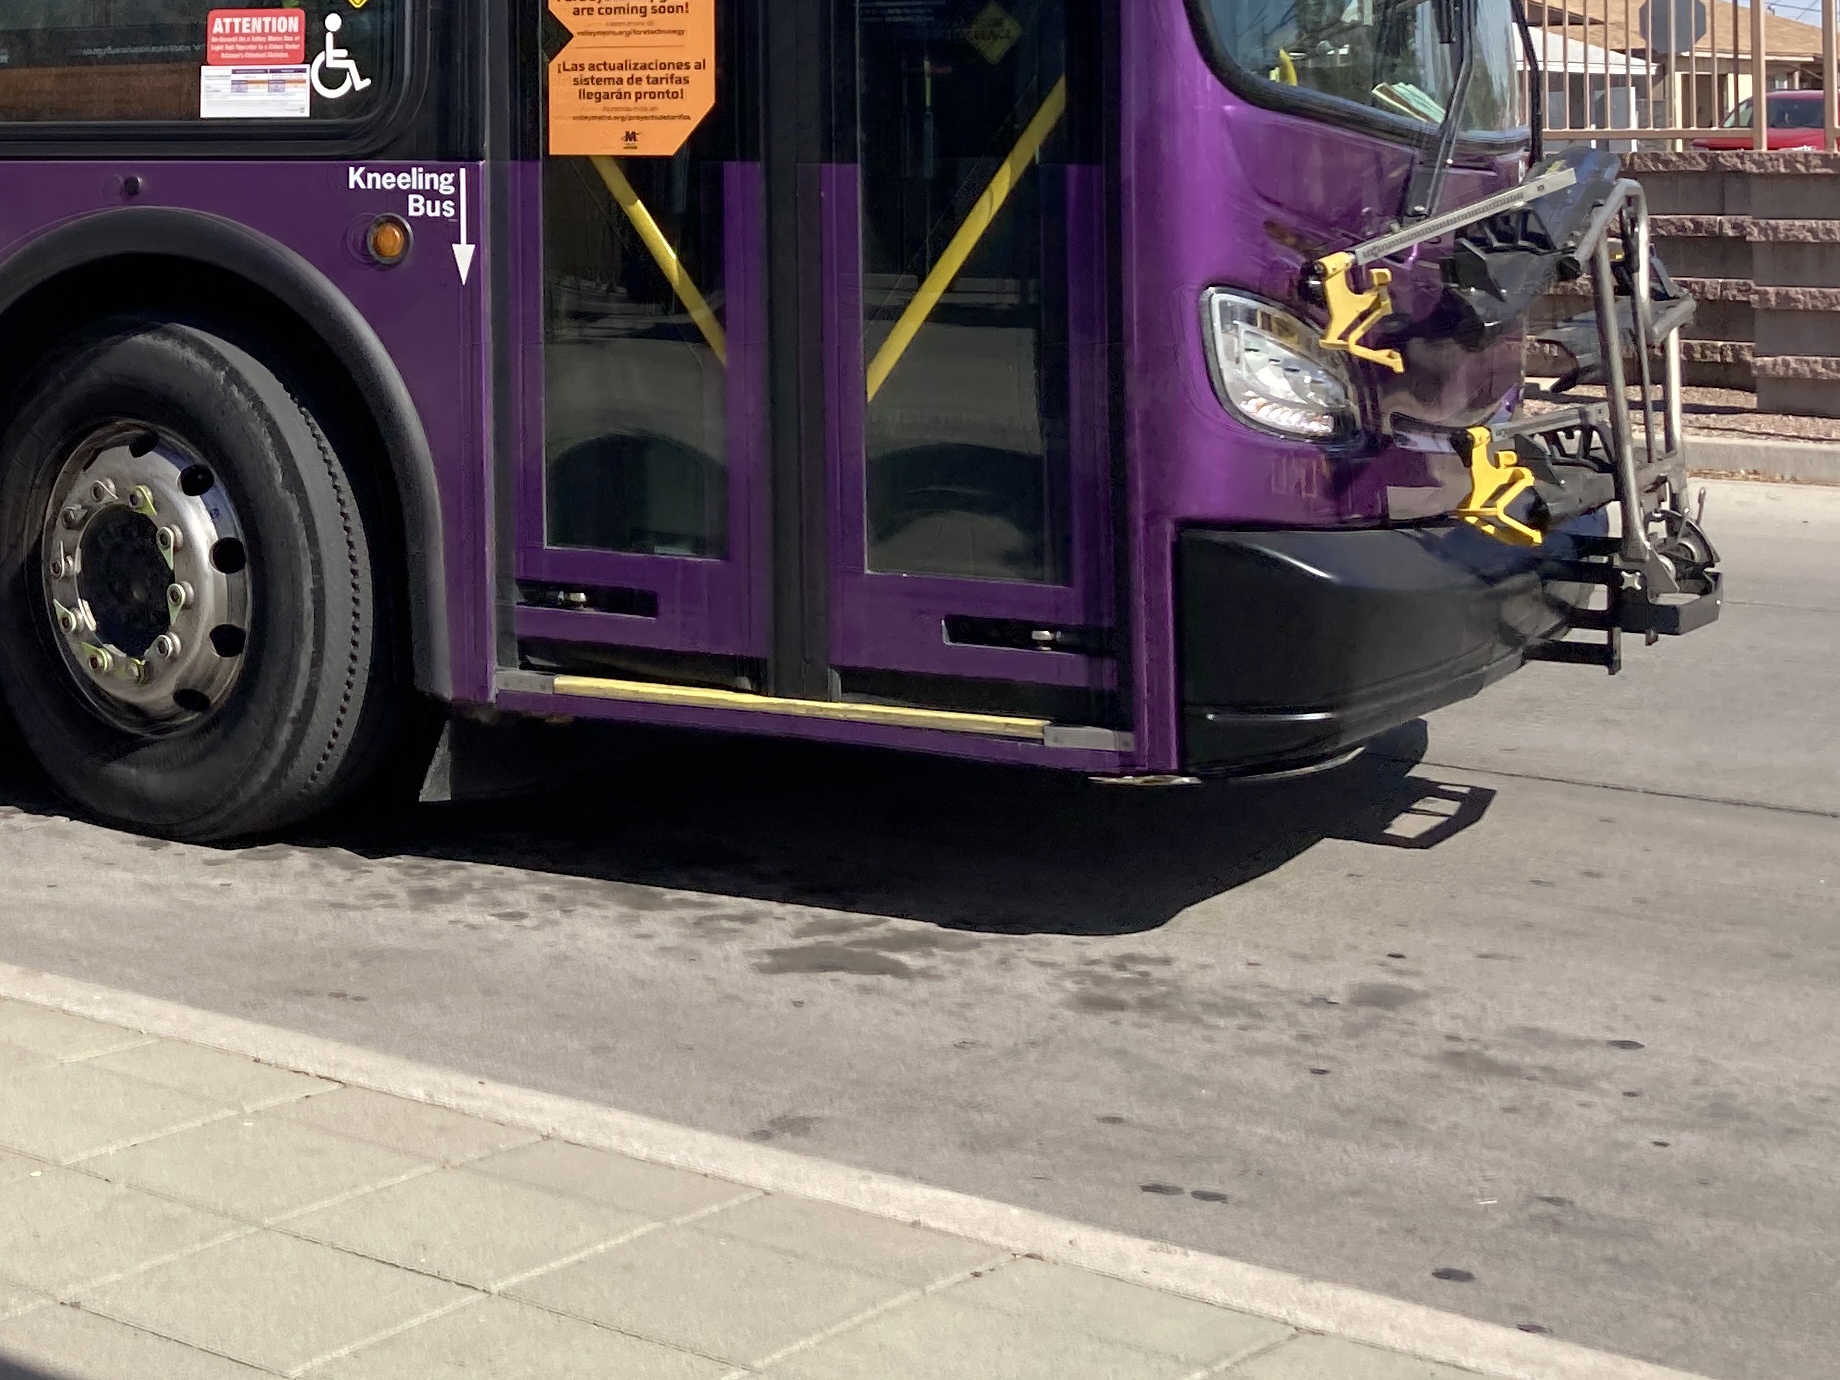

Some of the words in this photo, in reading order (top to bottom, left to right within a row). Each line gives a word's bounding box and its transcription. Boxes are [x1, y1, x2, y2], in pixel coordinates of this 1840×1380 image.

[572, 6, 594, 16] are
[598, 3, 648, 18] coming
[650, 2, 689, 14] soon!
[212, 16, 299, 34] ATTENTION
[557, 61, 586, 74] ¡Las
[587, 58, 691, 71] actualizaciones
[693, 58, 706, 70] al
[572, 74, 624, 86] sistema
[626, 74, 642, 86] de
[645, 73, 690, 85] tarifas
[578, 88, 631, 103] llegarán
[634, 88, 684, 103] pronto!
[348, 167, 455, 195] Kneeling
[408, 194, 455, 217] Bus
